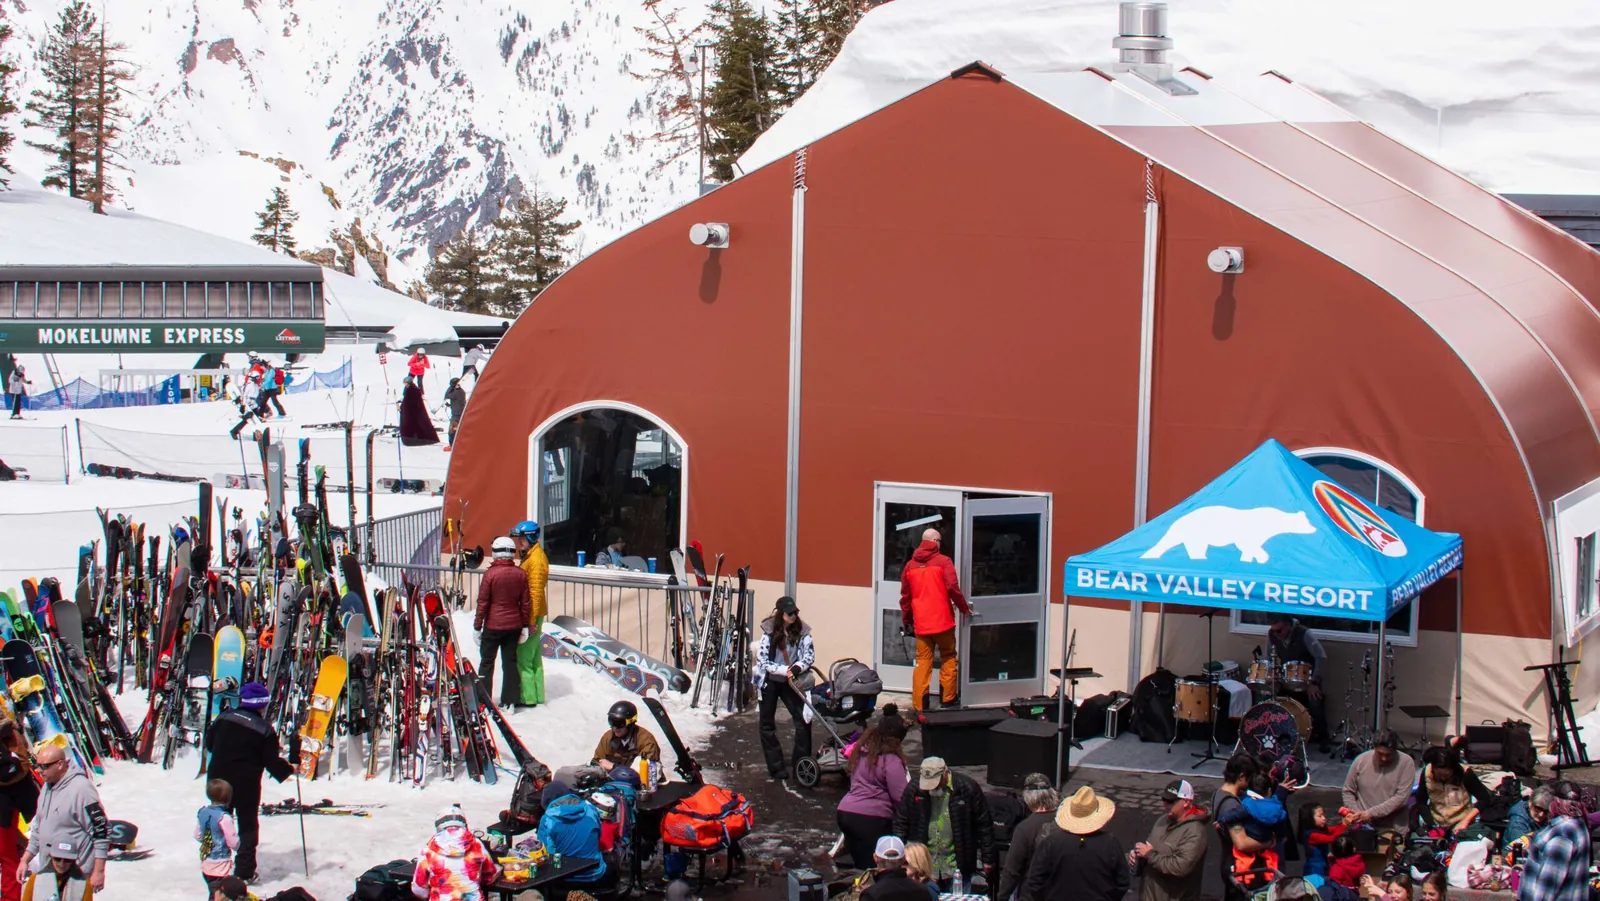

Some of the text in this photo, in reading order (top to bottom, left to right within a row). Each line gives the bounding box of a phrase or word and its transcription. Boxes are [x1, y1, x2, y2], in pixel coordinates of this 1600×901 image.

[37, 327, 246, 345] MOKELUMNE EXPRESS
[1076, 567, 1373, 611] BEAR VALLEY RESORT
[1391, 579, 1415, 608] BEAR
[1411, 562, 1440, 591] VALLEY
